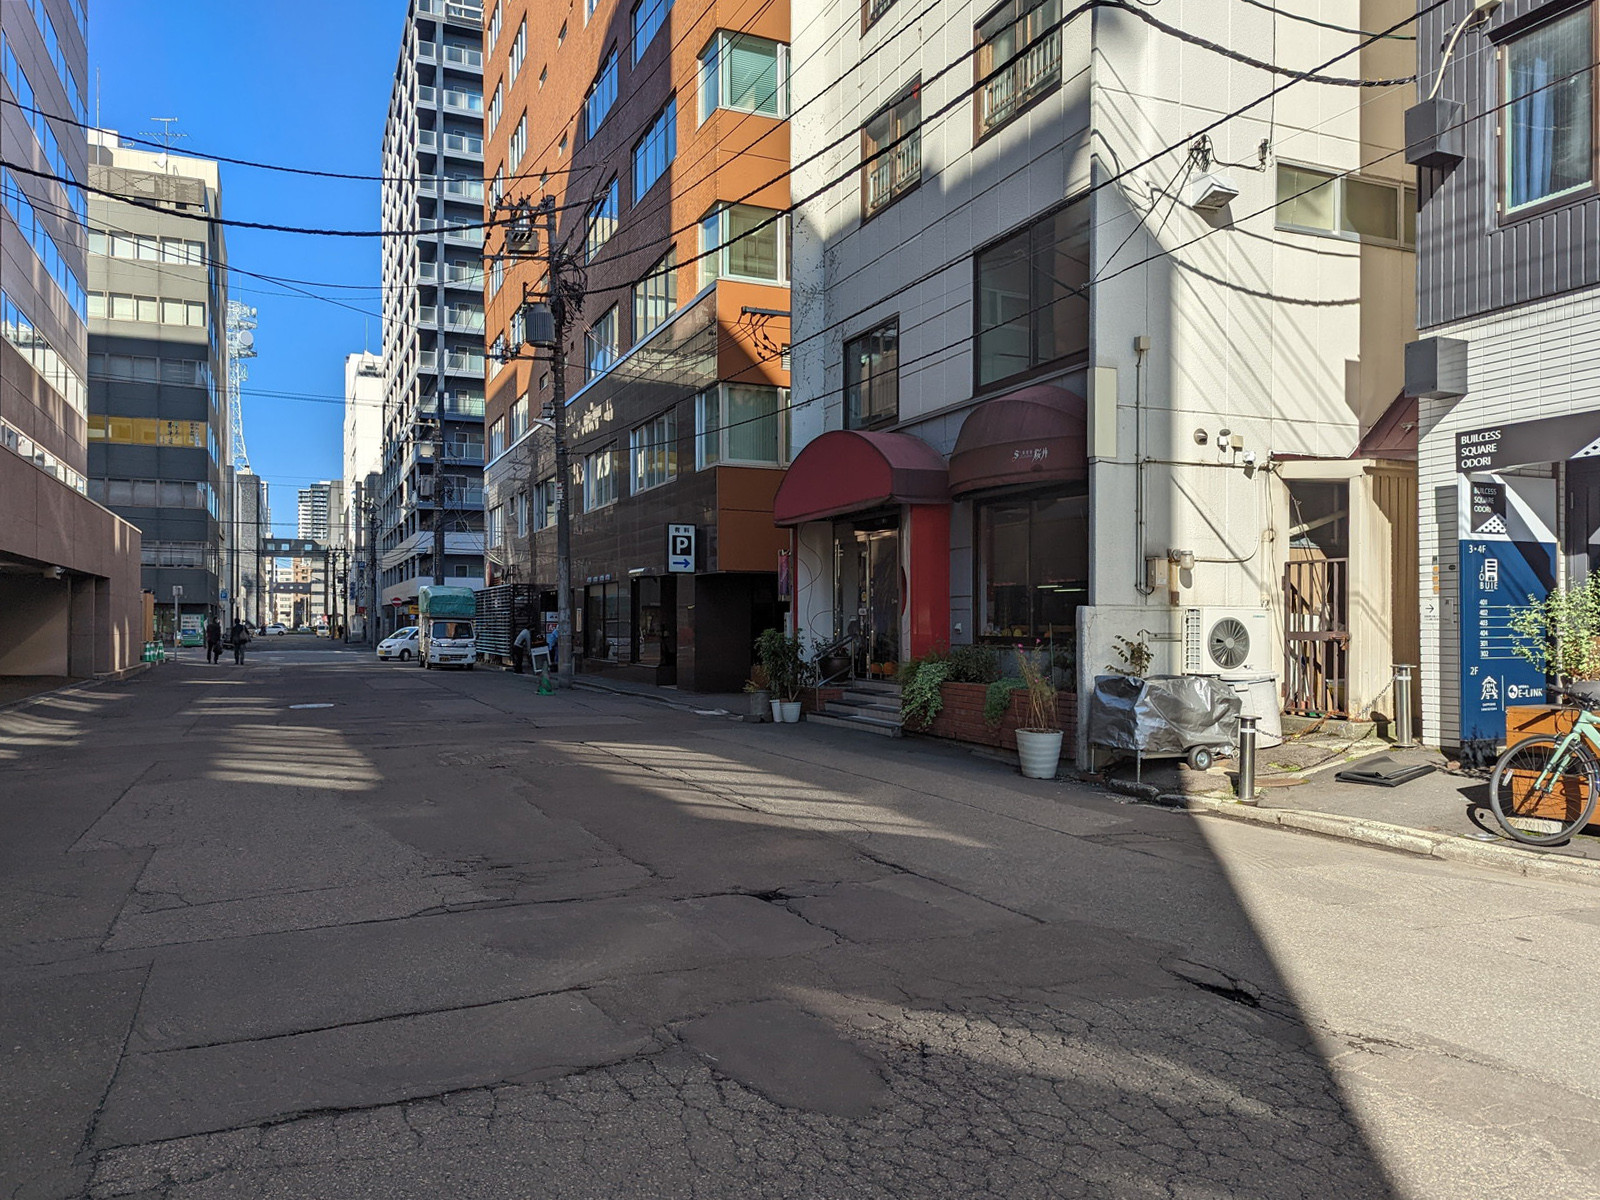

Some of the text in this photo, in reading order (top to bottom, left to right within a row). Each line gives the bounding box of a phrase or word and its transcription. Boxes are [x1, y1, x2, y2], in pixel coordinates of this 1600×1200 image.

[1461, 430, 1501, 444] BUILCESS
[1461, 443, 1497, 457] SQUARE
[1461, 456, 1491, 468] ODORI
[1474, 487, 1497, 495] BUILCESS
[1474, 496, 1494, 504] SQUARE
[1474, 505, 1491, 513] ODORI
[676, 537, 689, 554] P
[1470, 666, 1479, 675] 2F
